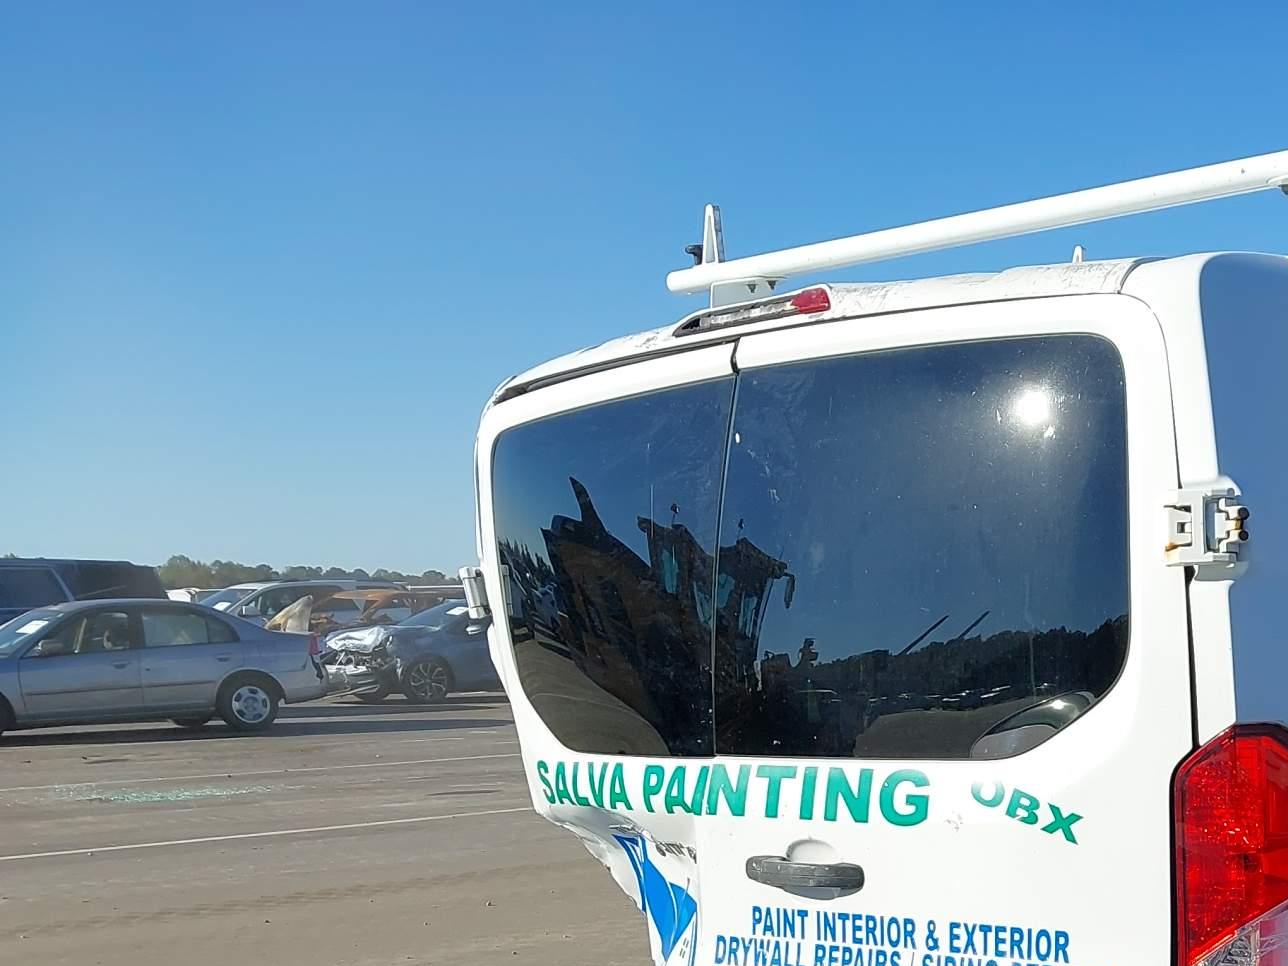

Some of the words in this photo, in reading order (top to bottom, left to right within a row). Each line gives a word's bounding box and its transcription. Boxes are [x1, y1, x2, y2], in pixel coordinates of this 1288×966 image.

[537, 760, 631, 810] SALVA
[642, 763, 930, 827] PAINTING
[971, 779, 1085, 845] OBX
[751, 906, 808, 941] PAINT
[816, 910, 917, 949] INTERIOR
[926, 920, 940, 951] &
[950, 922, 1070, 964] EXTERIOR
